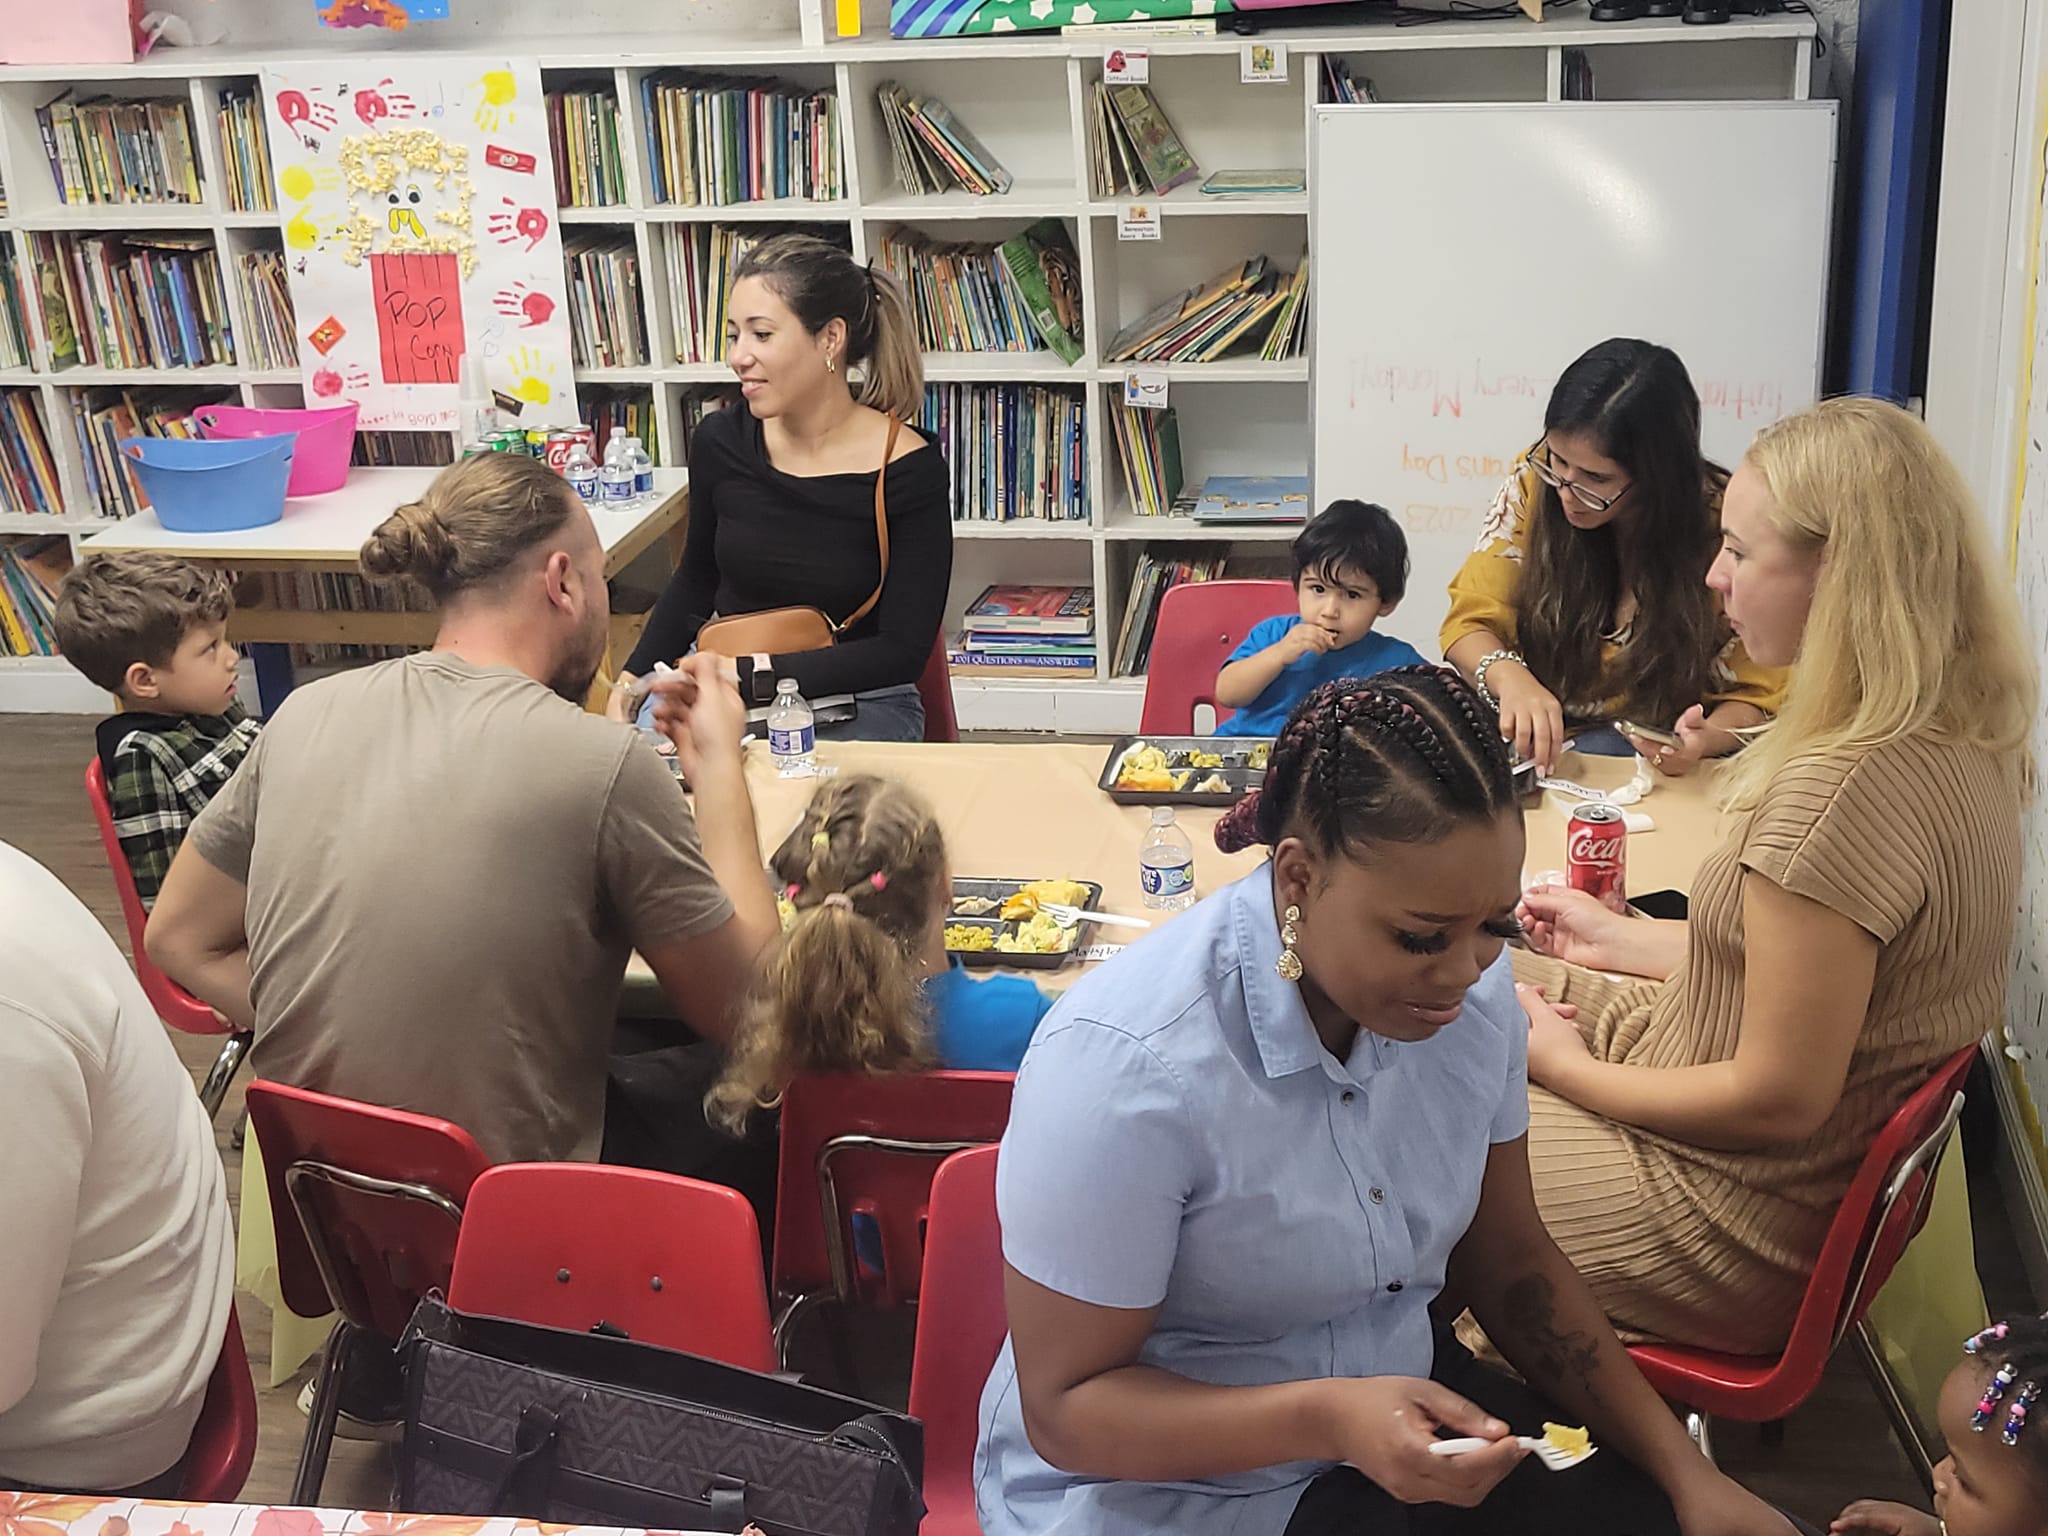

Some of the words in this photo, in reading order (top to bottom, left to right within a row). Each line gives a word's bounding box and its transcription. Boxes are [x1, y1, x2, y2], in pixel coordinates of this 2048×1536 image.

[383, 290, 447, 331] POP
[1401, 444, 1448, 484] Day
[1404, 503, 1471, 533] 2023
[971, 655, 1023, 665] QUESTIONS
[1037, 657, 1079, 666] ANSWERS
